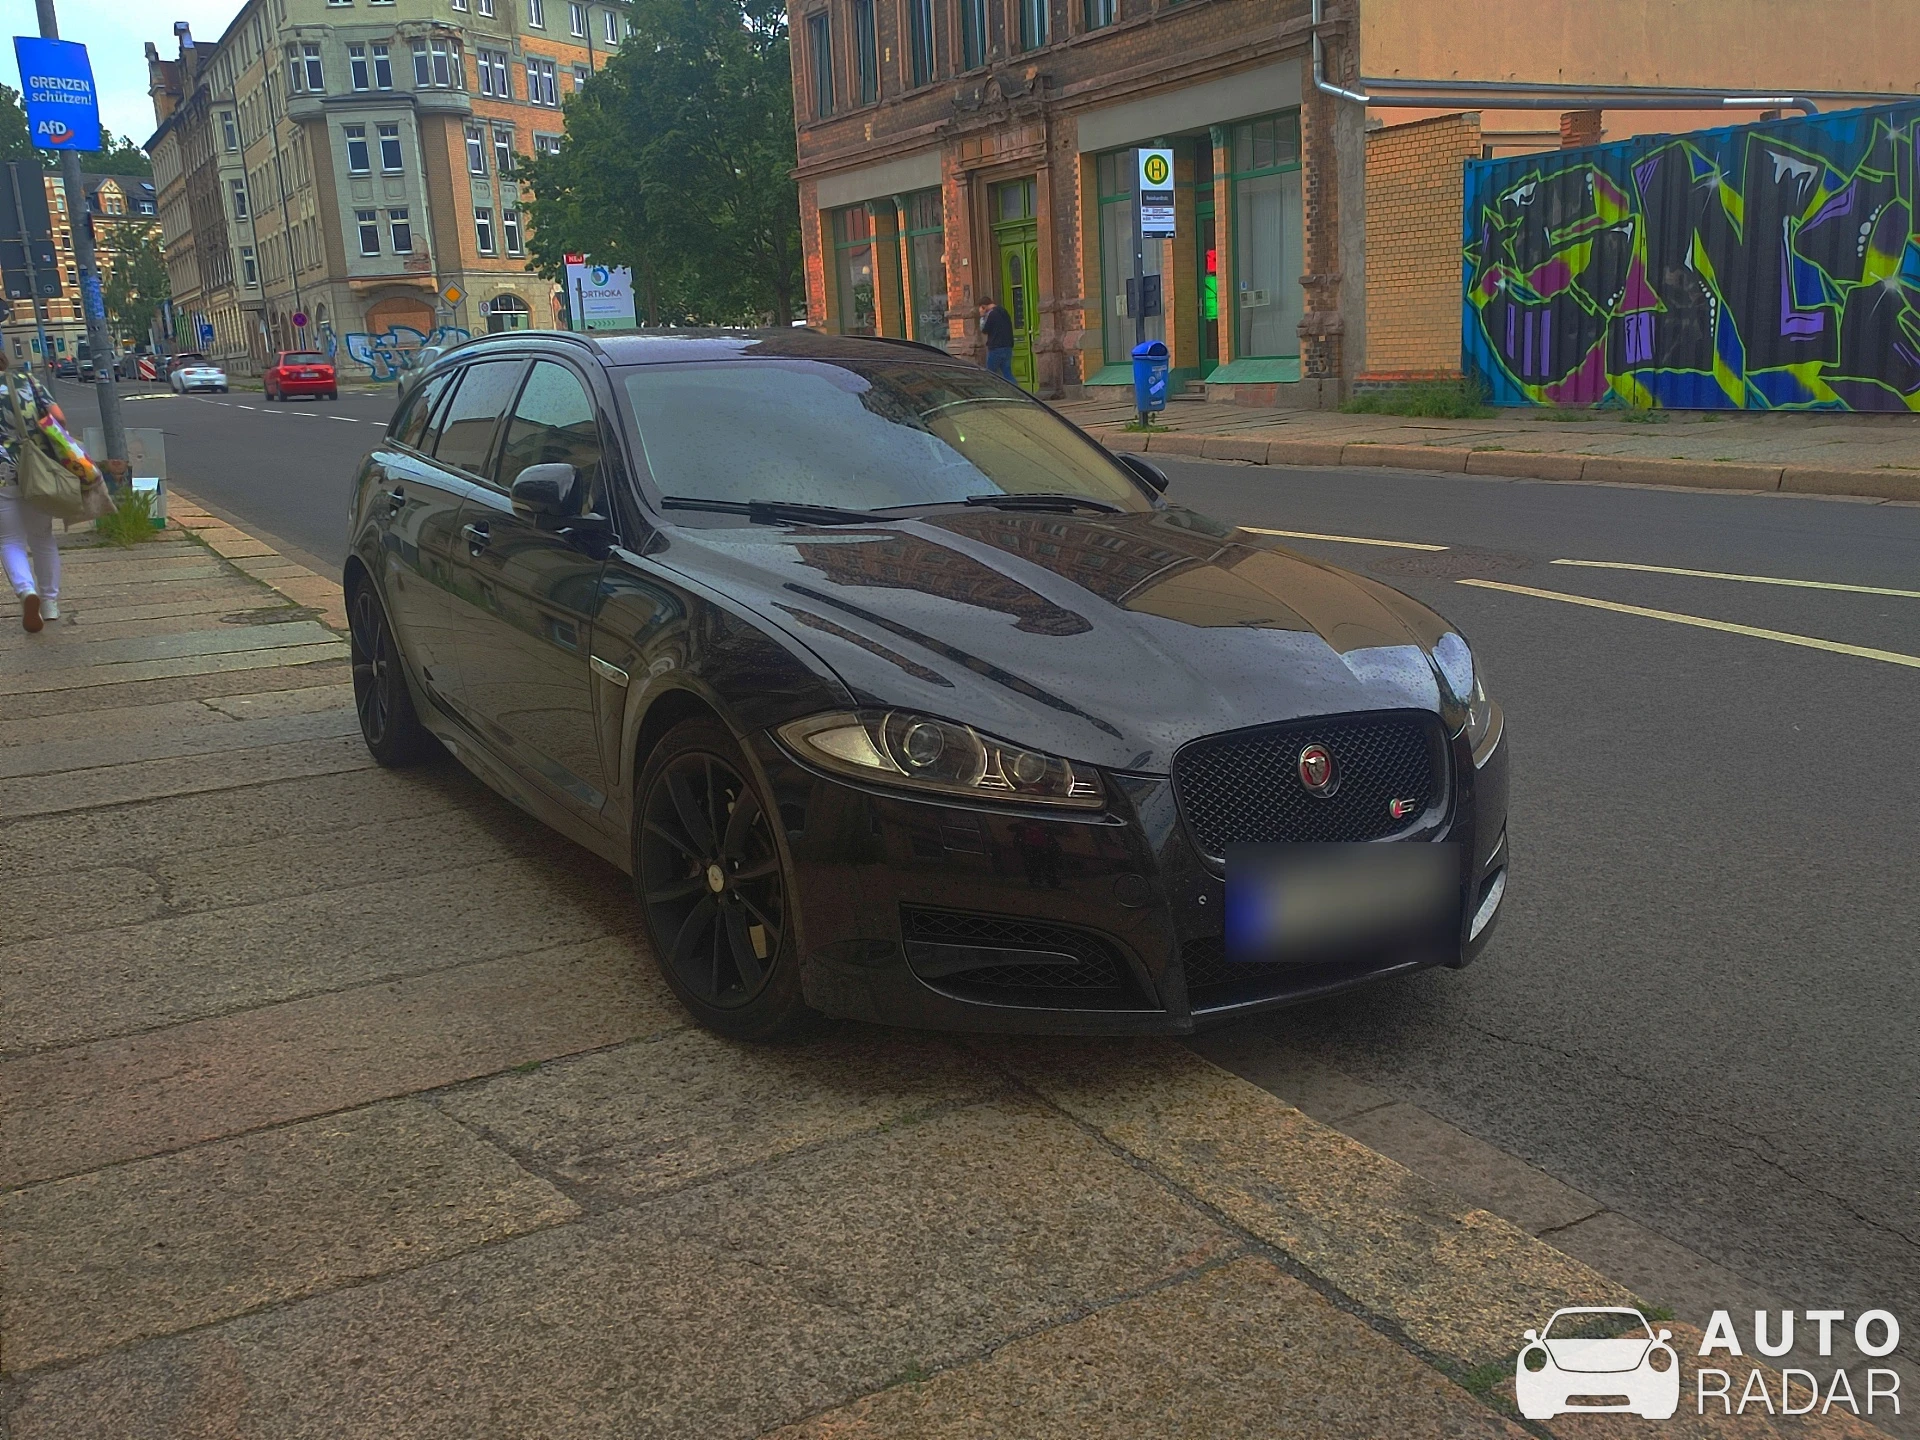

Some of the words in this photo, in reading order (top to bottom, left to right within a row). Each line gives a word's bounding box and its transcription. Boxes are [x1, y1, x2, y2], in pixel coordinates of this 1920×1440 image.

[29, 76, 90, 92] GRENZEN
[31, 90, 92, 105] schützen!
[38, 120, 67, 135] AfD
[1151, 160, 1162, 178] H
[581, 289, 622, 298] ORTHOKA
